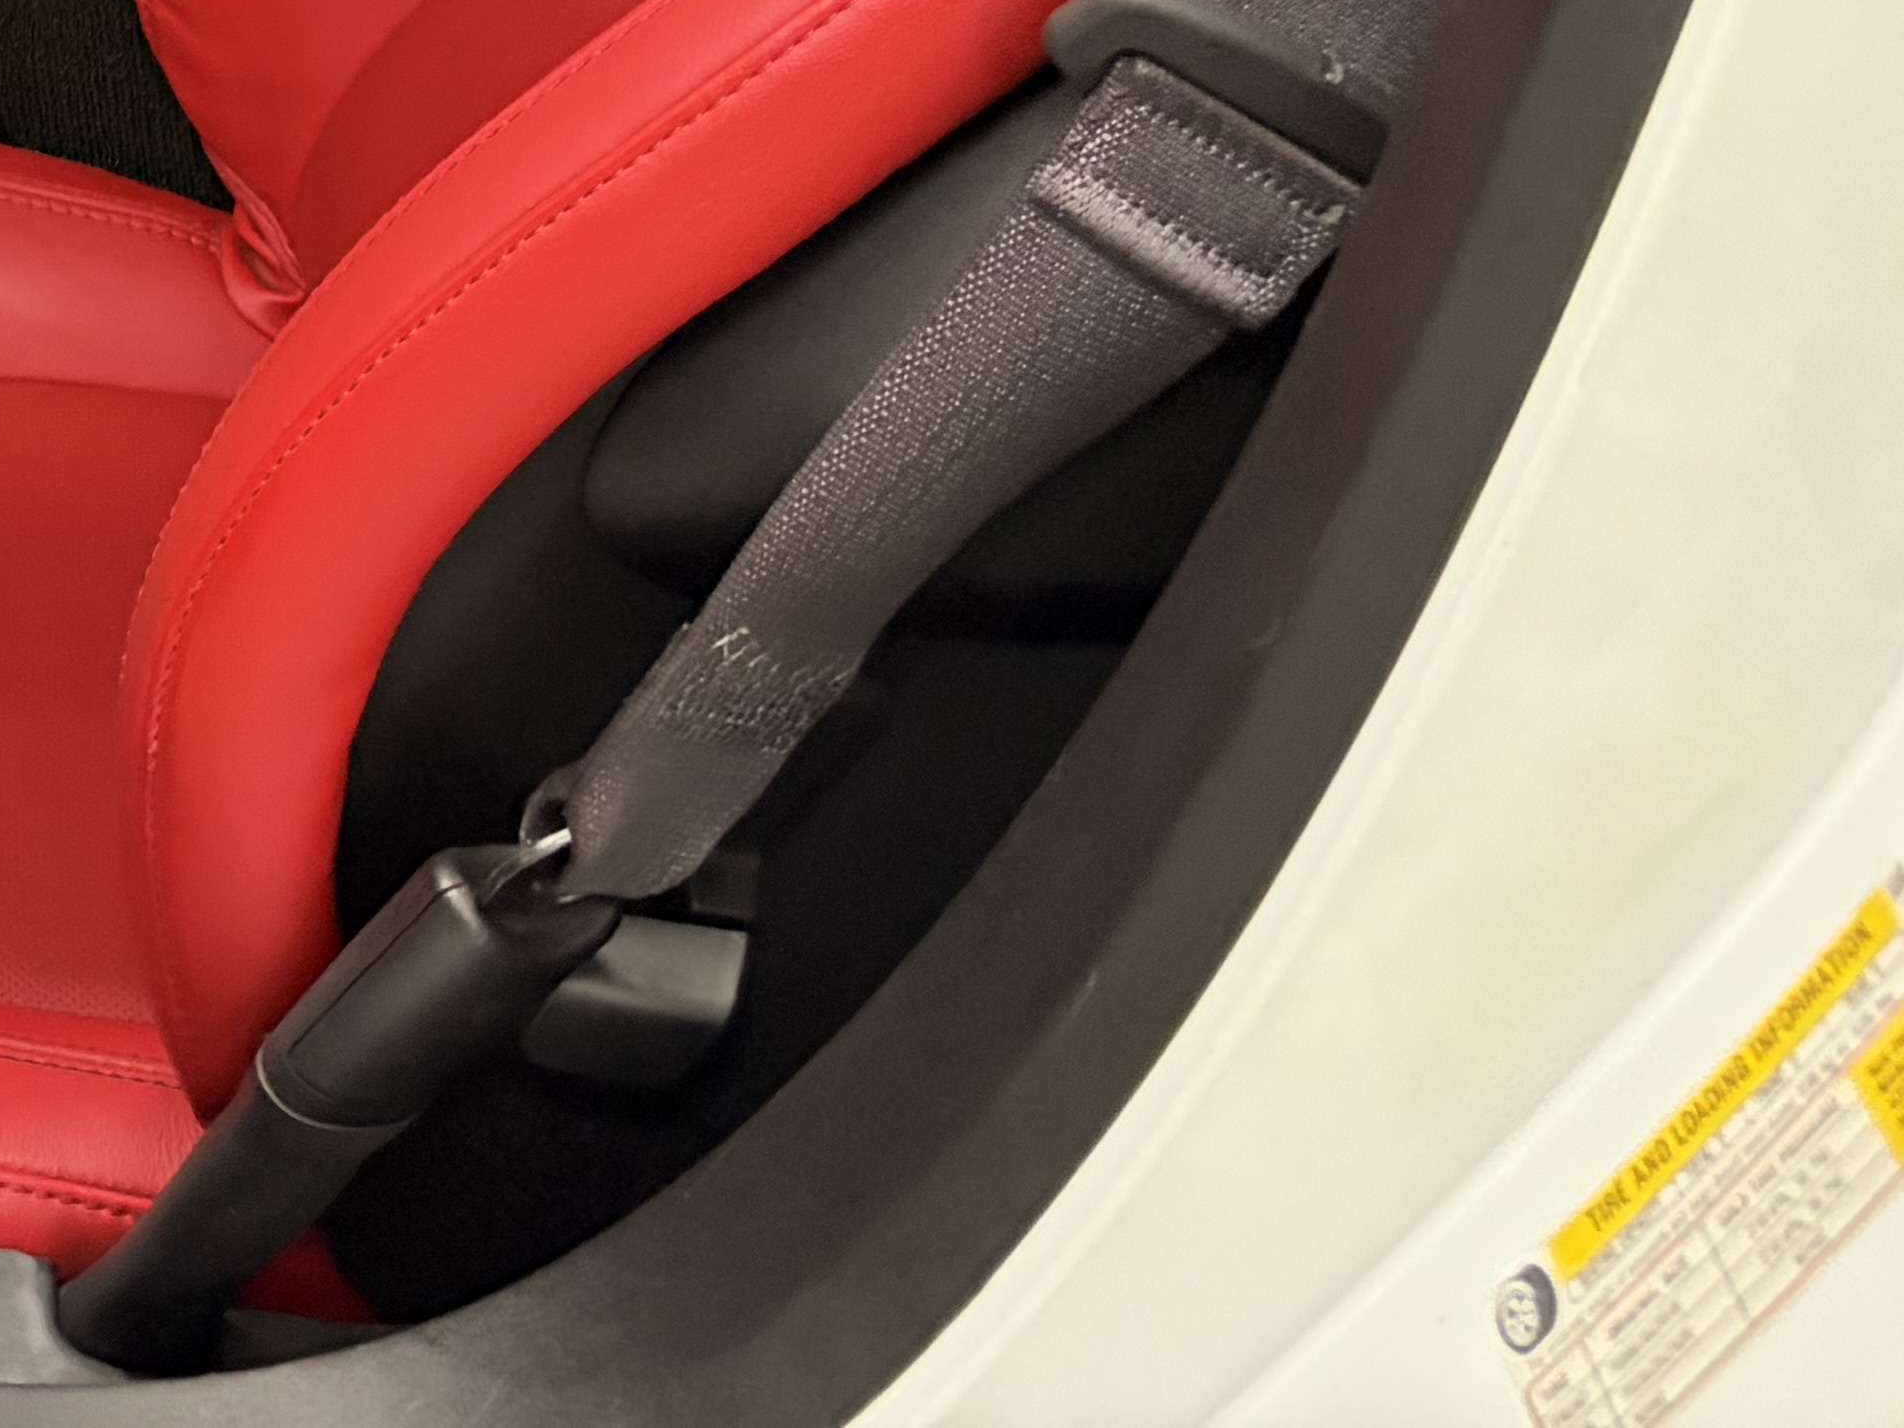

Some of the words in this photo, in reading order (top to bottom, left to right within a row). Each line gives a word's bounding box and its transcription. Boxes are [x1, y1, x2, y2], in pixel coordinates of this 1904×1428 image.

[1585, 1177, 1631, 1232] TIRE
[1630, 1137, 1673, 1188] AND
[1669, 1054, 1750, 1147] LOADING
[1748, 920, 1873, 1062] INFORMATION
